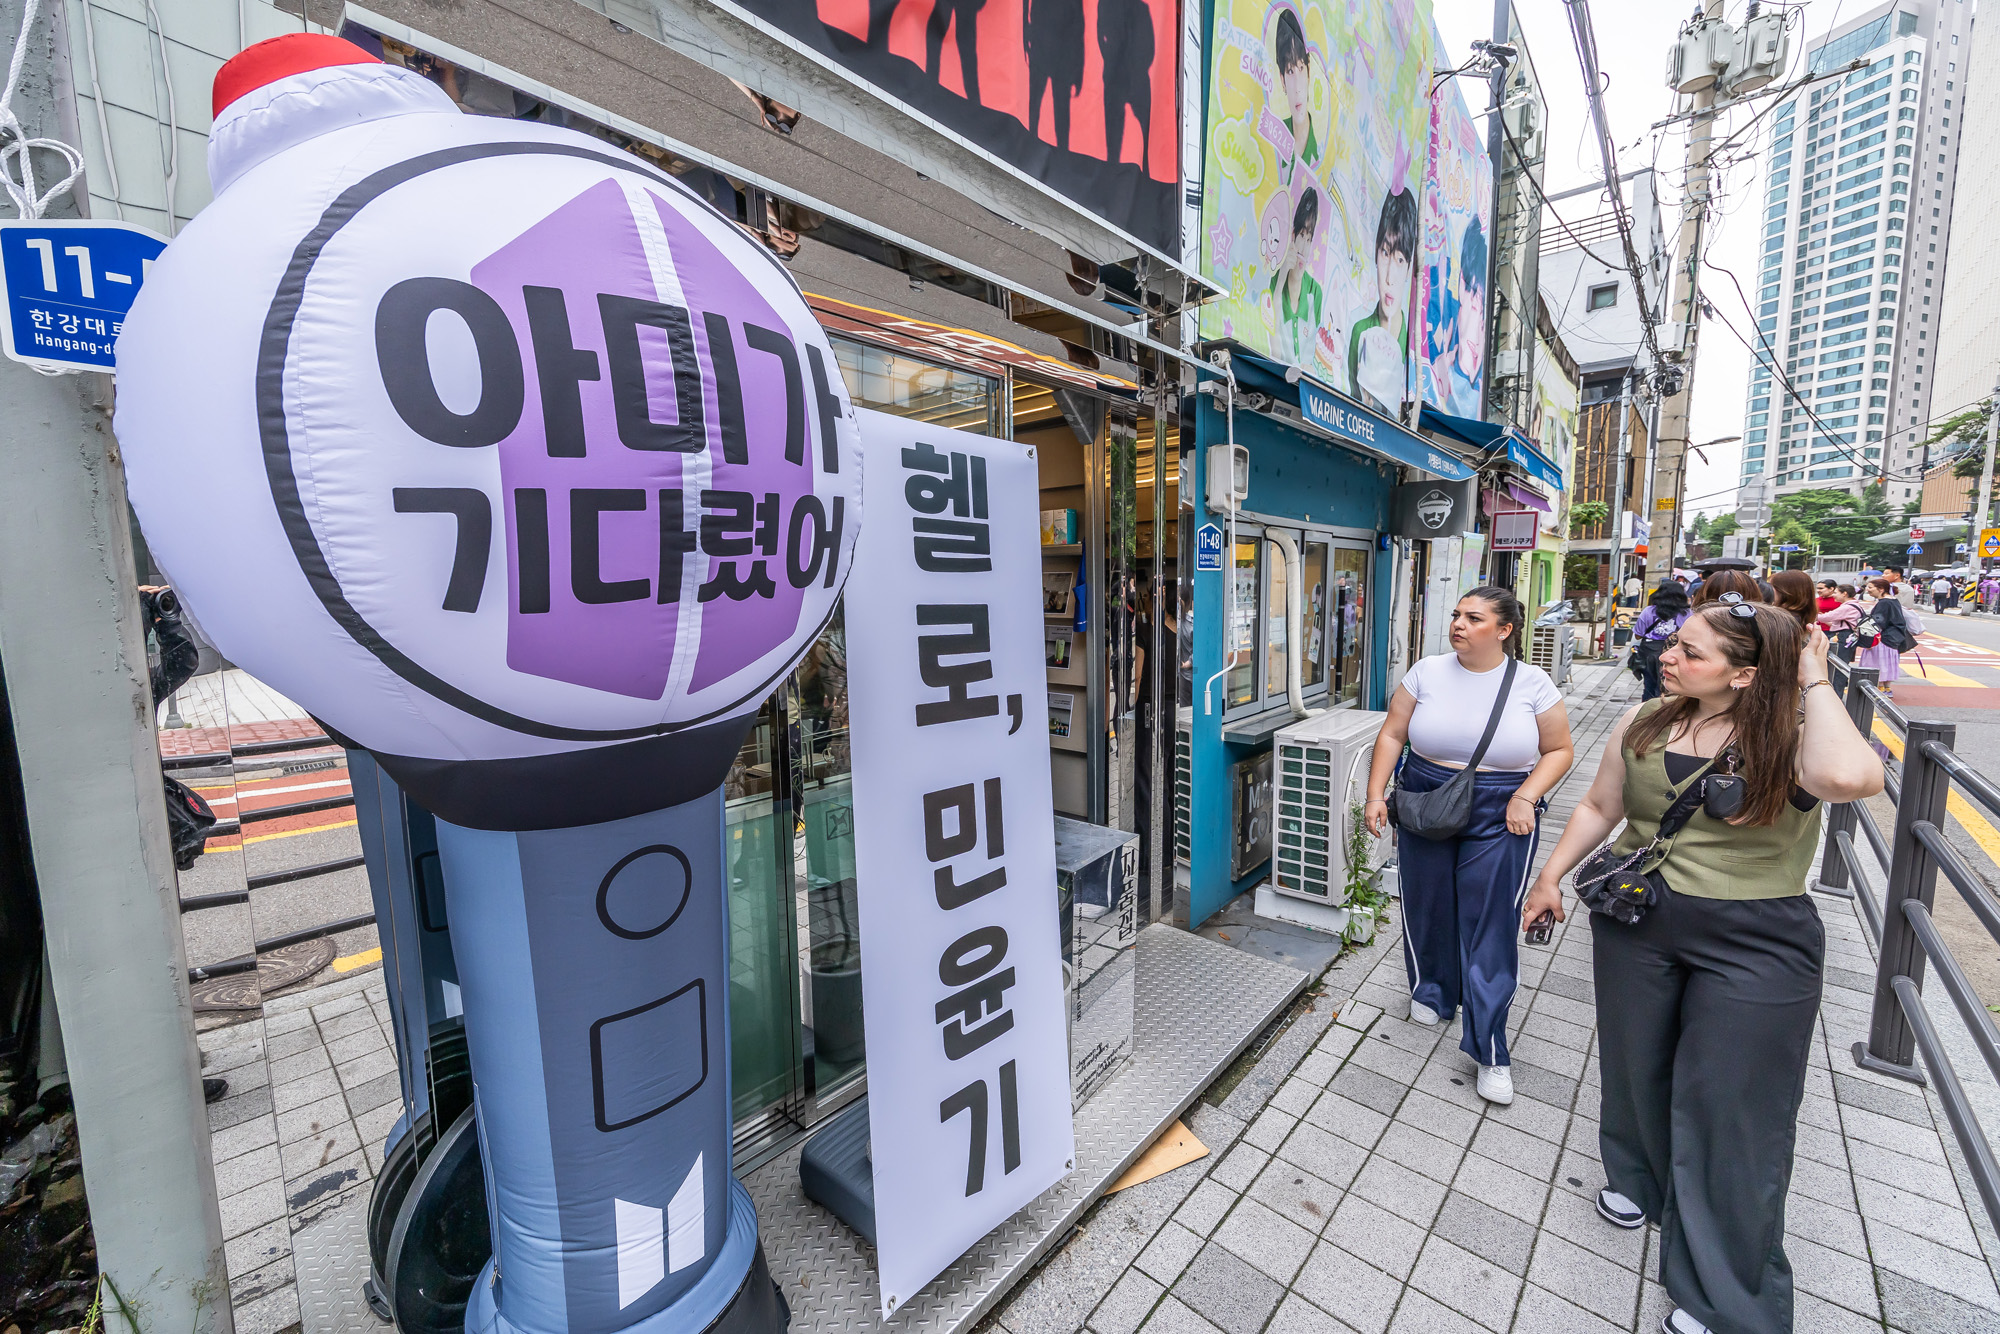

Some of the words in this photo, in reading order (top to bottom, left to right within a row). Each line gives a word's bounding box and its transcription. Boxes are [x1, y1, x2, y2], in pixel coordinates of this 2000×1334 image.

[1242, 54, 1273, 94] SUNOO
[375, 276, 843, 475] 아미가
[1309, 394, 1345, 429] MARINE
[1347, 413, 1375, 442] COFFEE
[392, 482, 845, 615] 기다렸어
[1200, 532, 1220, 550] 11-48
[923, 776, 1022, 1198] 민윤기
